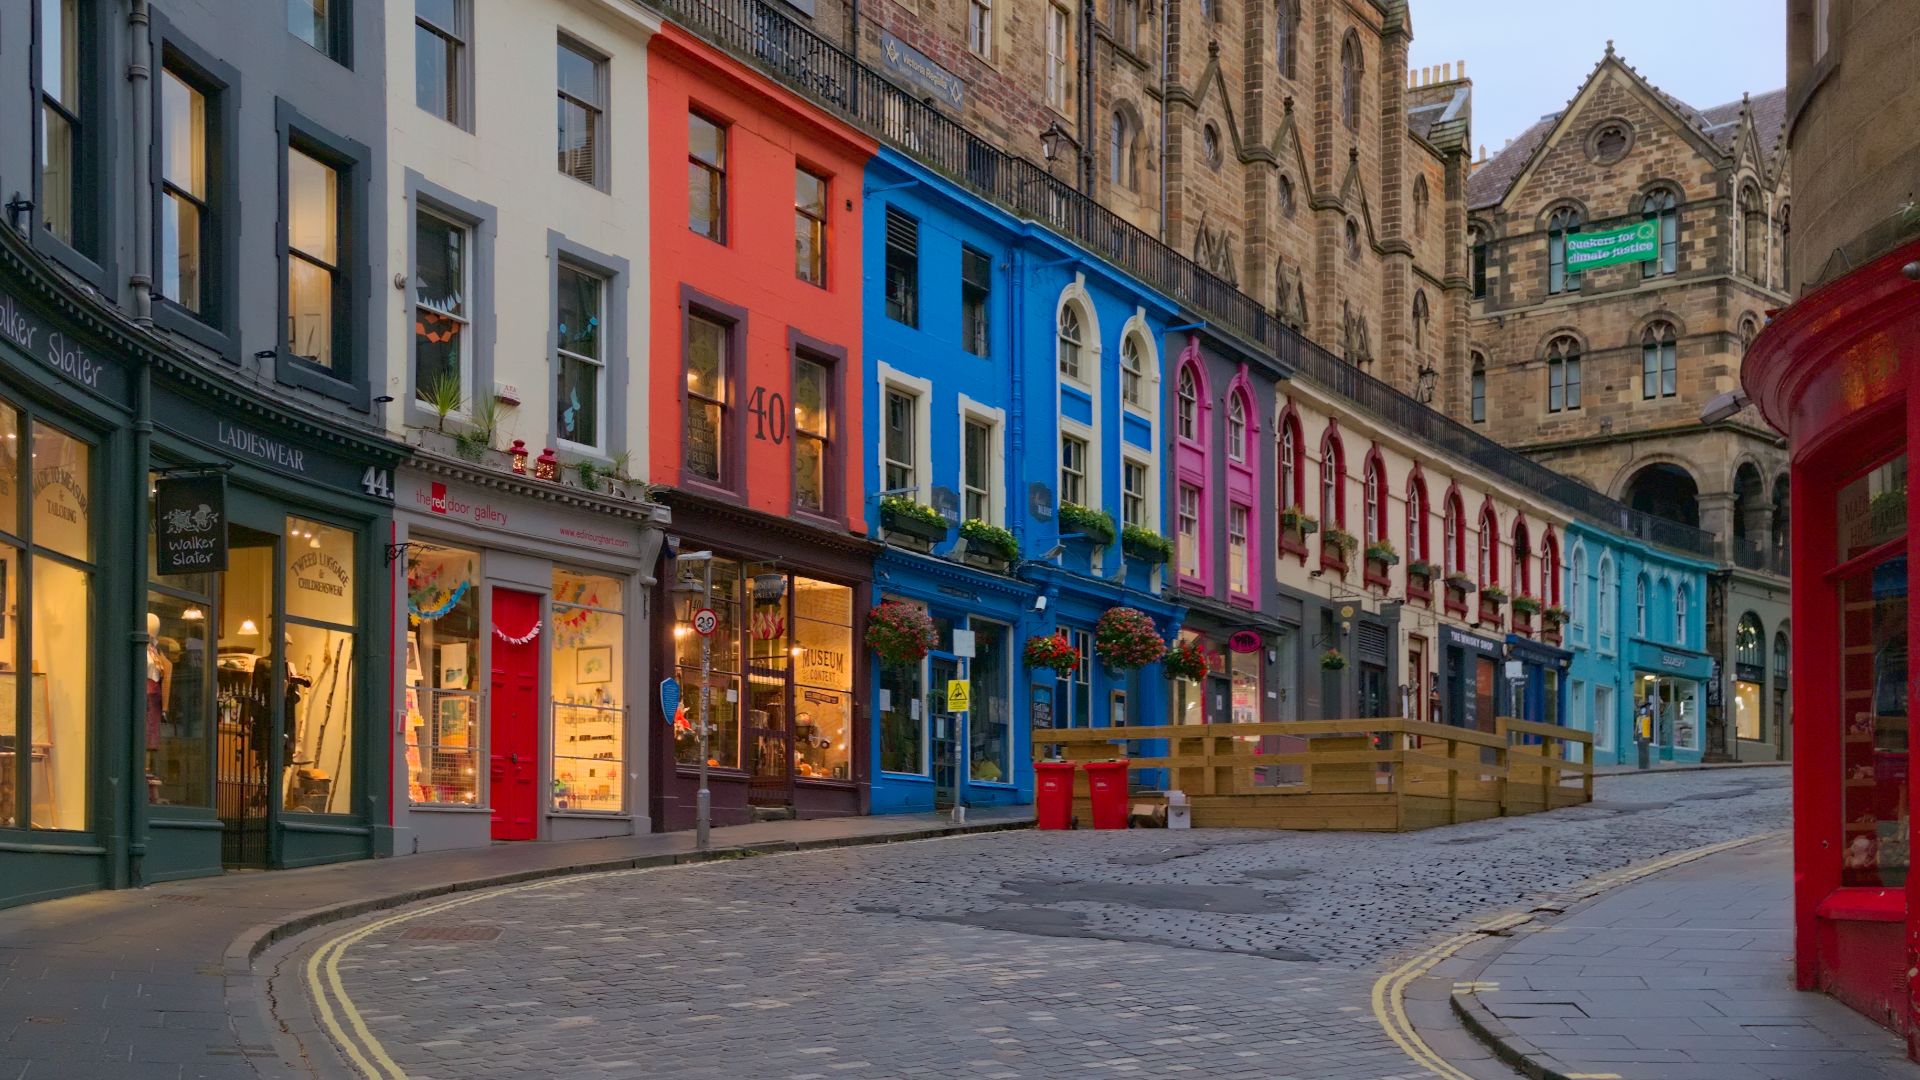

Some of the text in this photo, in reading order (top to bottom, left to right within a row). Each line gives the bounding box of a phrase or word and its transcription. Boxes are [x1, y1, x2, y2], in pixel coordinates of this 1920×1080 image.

[1568, 231, 1636, 251] Quakers for
[1568, 241, 1654, 265] climate justice
[0, 294, 103, 388] alker Slater
[747, 386, 786, 445] 40
[218, 421, 305, 472] LADIESWEAR
[46, 499, 77, 524] TAILORING
[416, 488, 508, 526] the red door gallery
[172, 550, 214, 566] Slater
[291, 552, 350, 588] TWEED LUGGAGE
[298, 577, 344, 598] CHILDRENSWEAR
[1480, 640, 1494, 652] SHOP
[802, 648, 844, 674] MUSEUM
